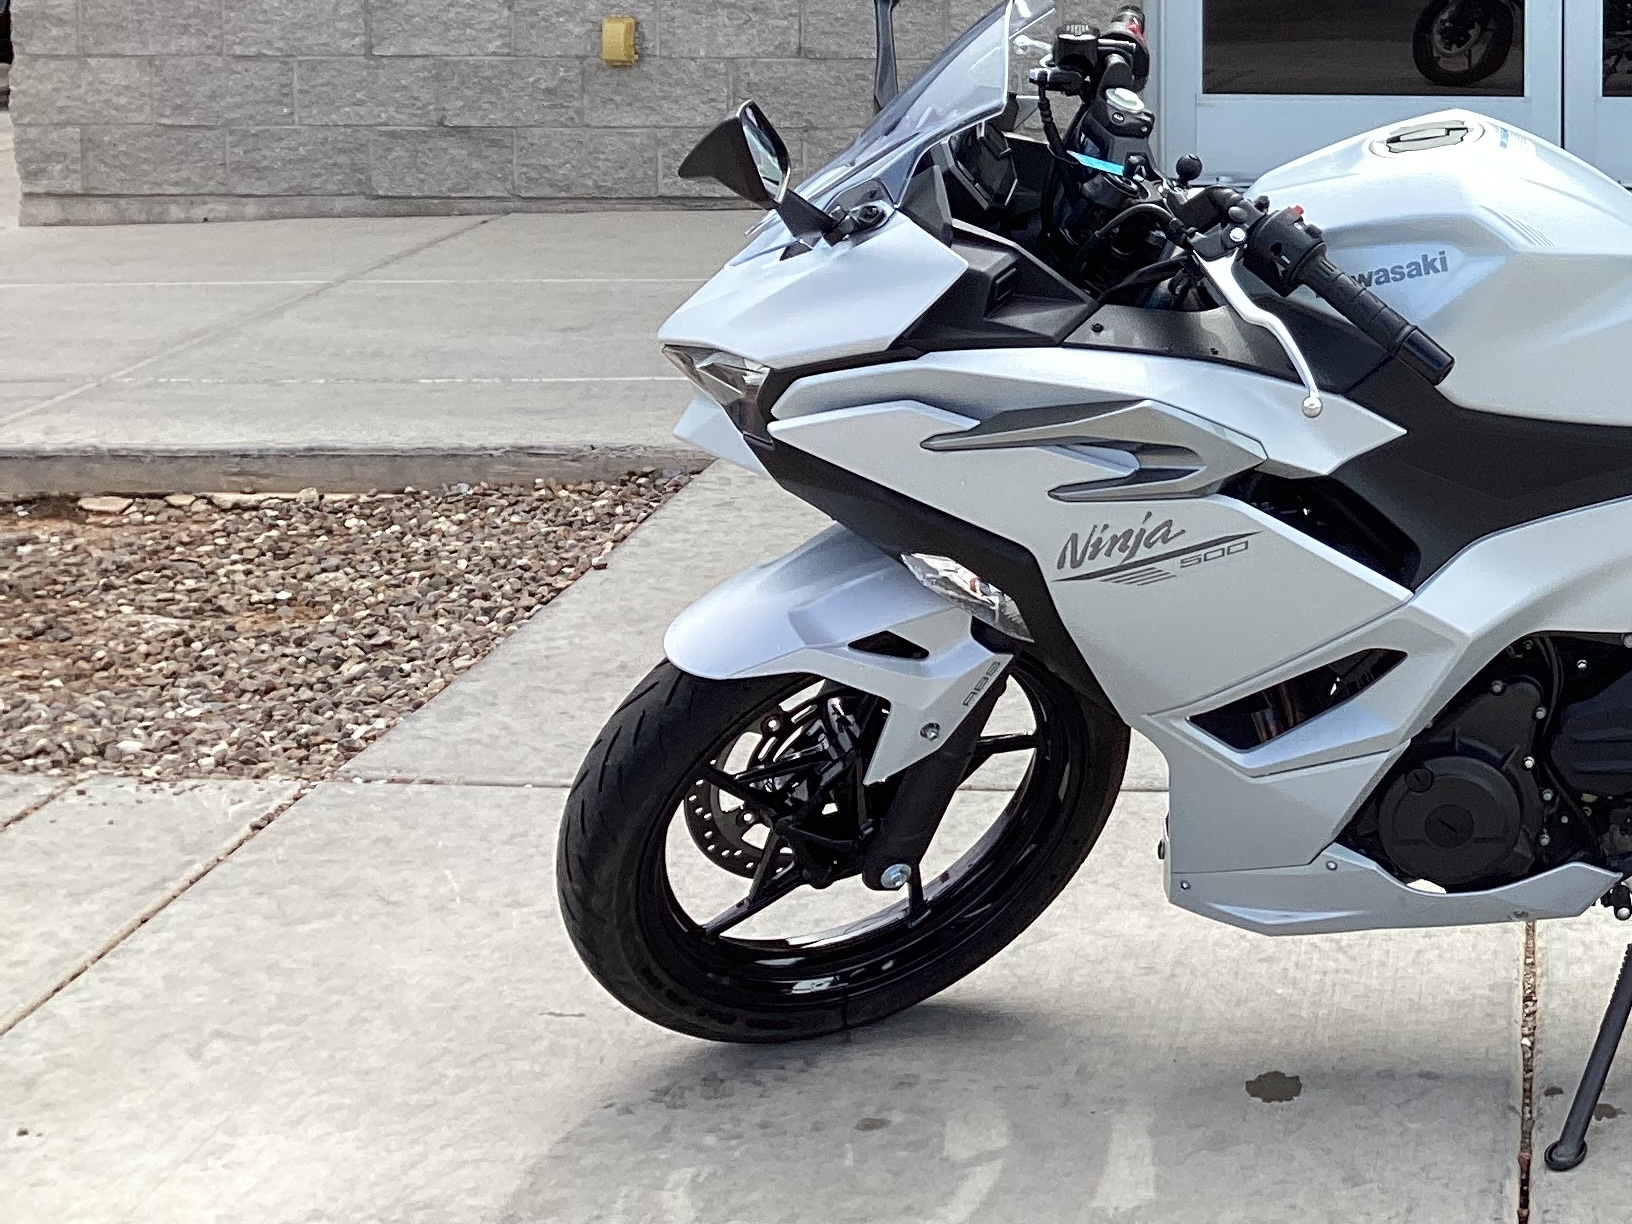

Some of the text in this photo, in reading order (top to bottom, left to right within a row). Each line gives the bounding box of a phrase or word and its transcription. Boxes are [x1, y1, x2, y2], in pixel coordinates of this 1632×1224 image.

[1353, 250, 1449, 287] wasaki
[1056, 511, 1186, 570] Ninja
[1180, 540, 1249, 569] 500
[962, 661, 1001, 707] ABS
